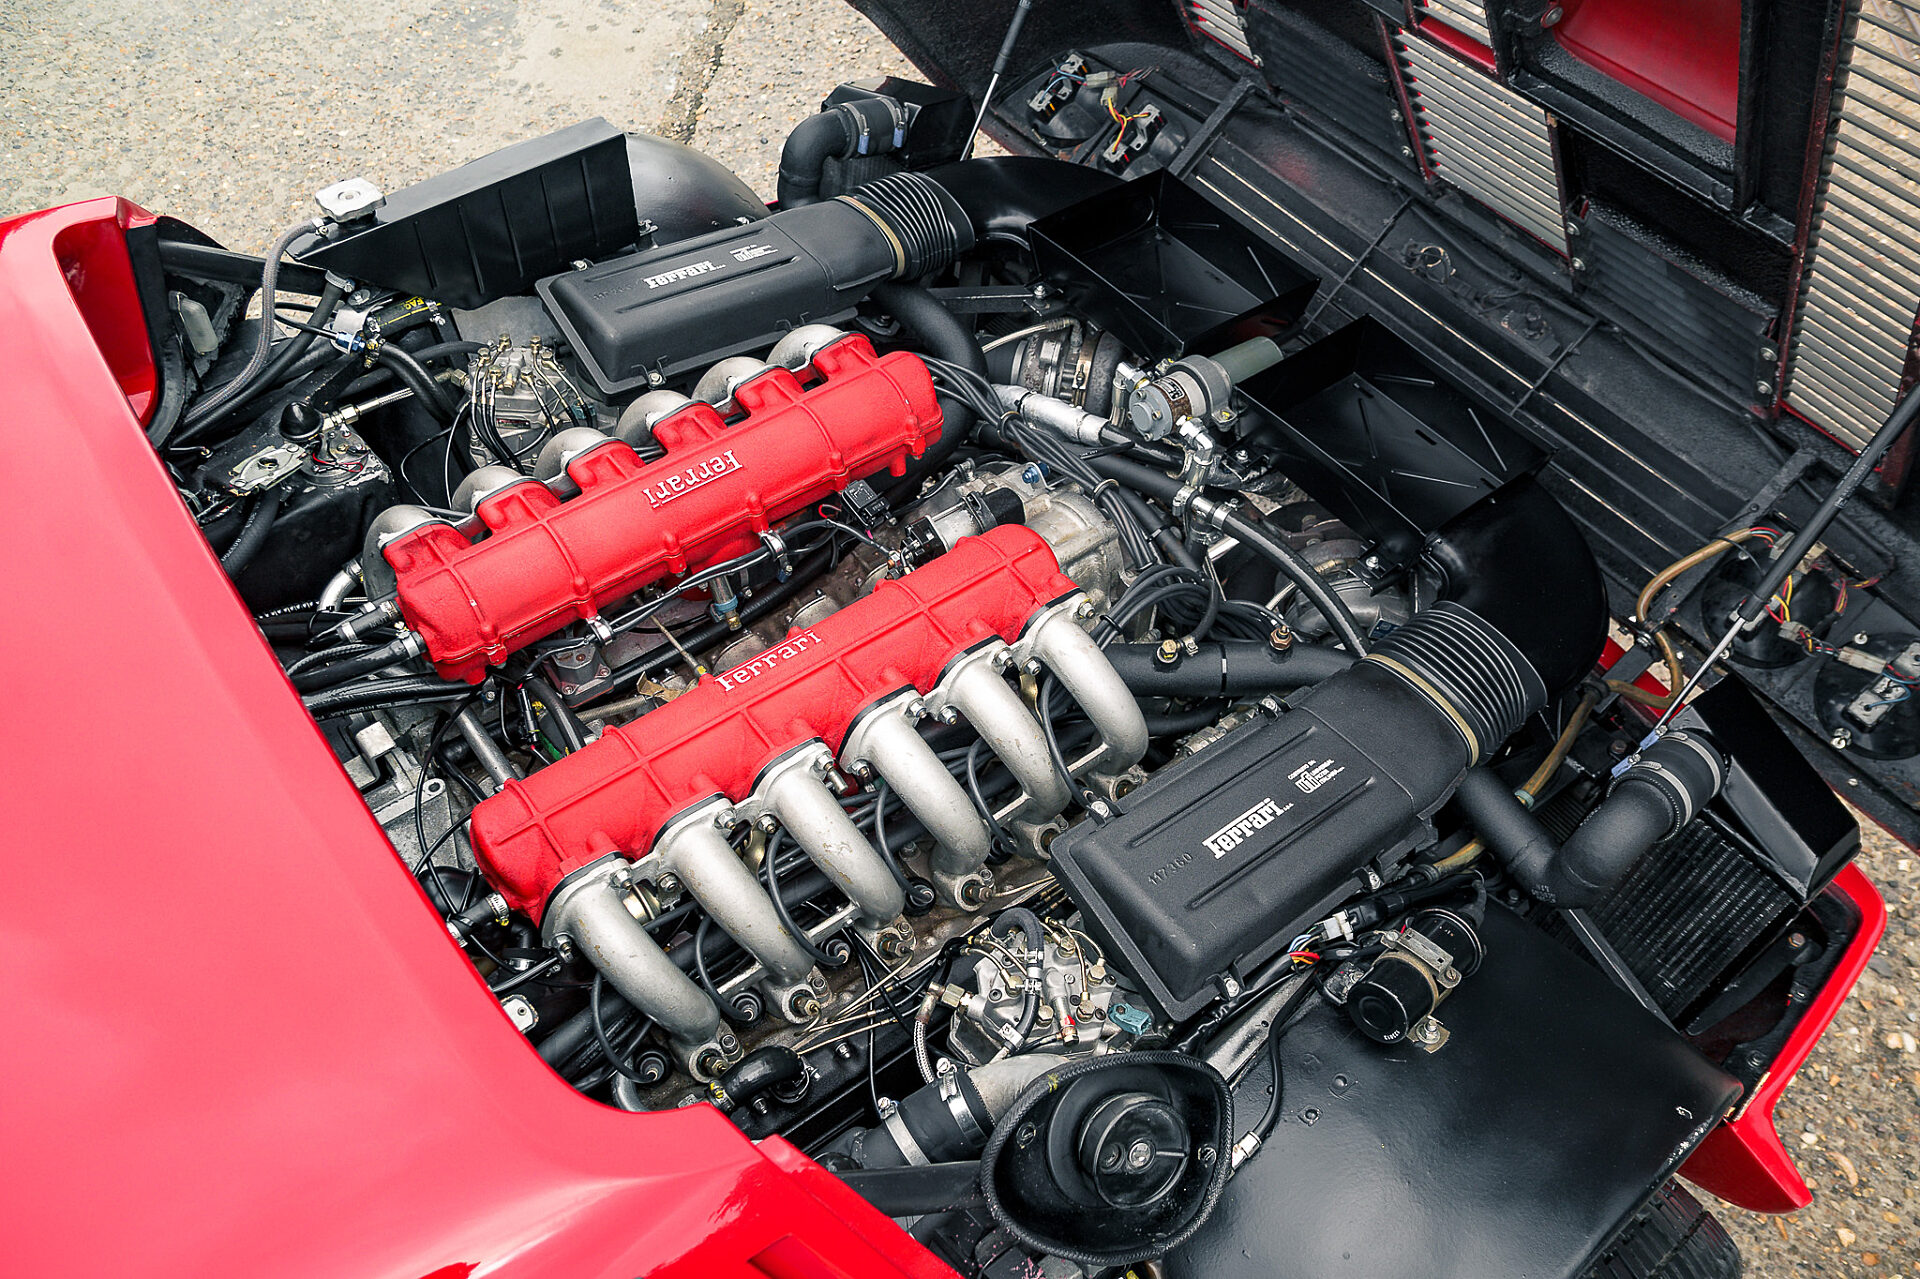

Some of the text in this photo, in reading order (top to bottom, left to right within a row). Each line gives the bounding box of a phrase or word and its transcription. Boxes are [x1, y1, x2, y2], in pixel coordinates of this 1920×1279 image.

[643, 261, 717, 289] Ferrari
[642, 449, 743, 509] Ferrari
[714, 629, 822, 692] Ferrari
[1201, 797, 1285, 860] Ferrari
[1148, 852, 1194, 886] 117360
